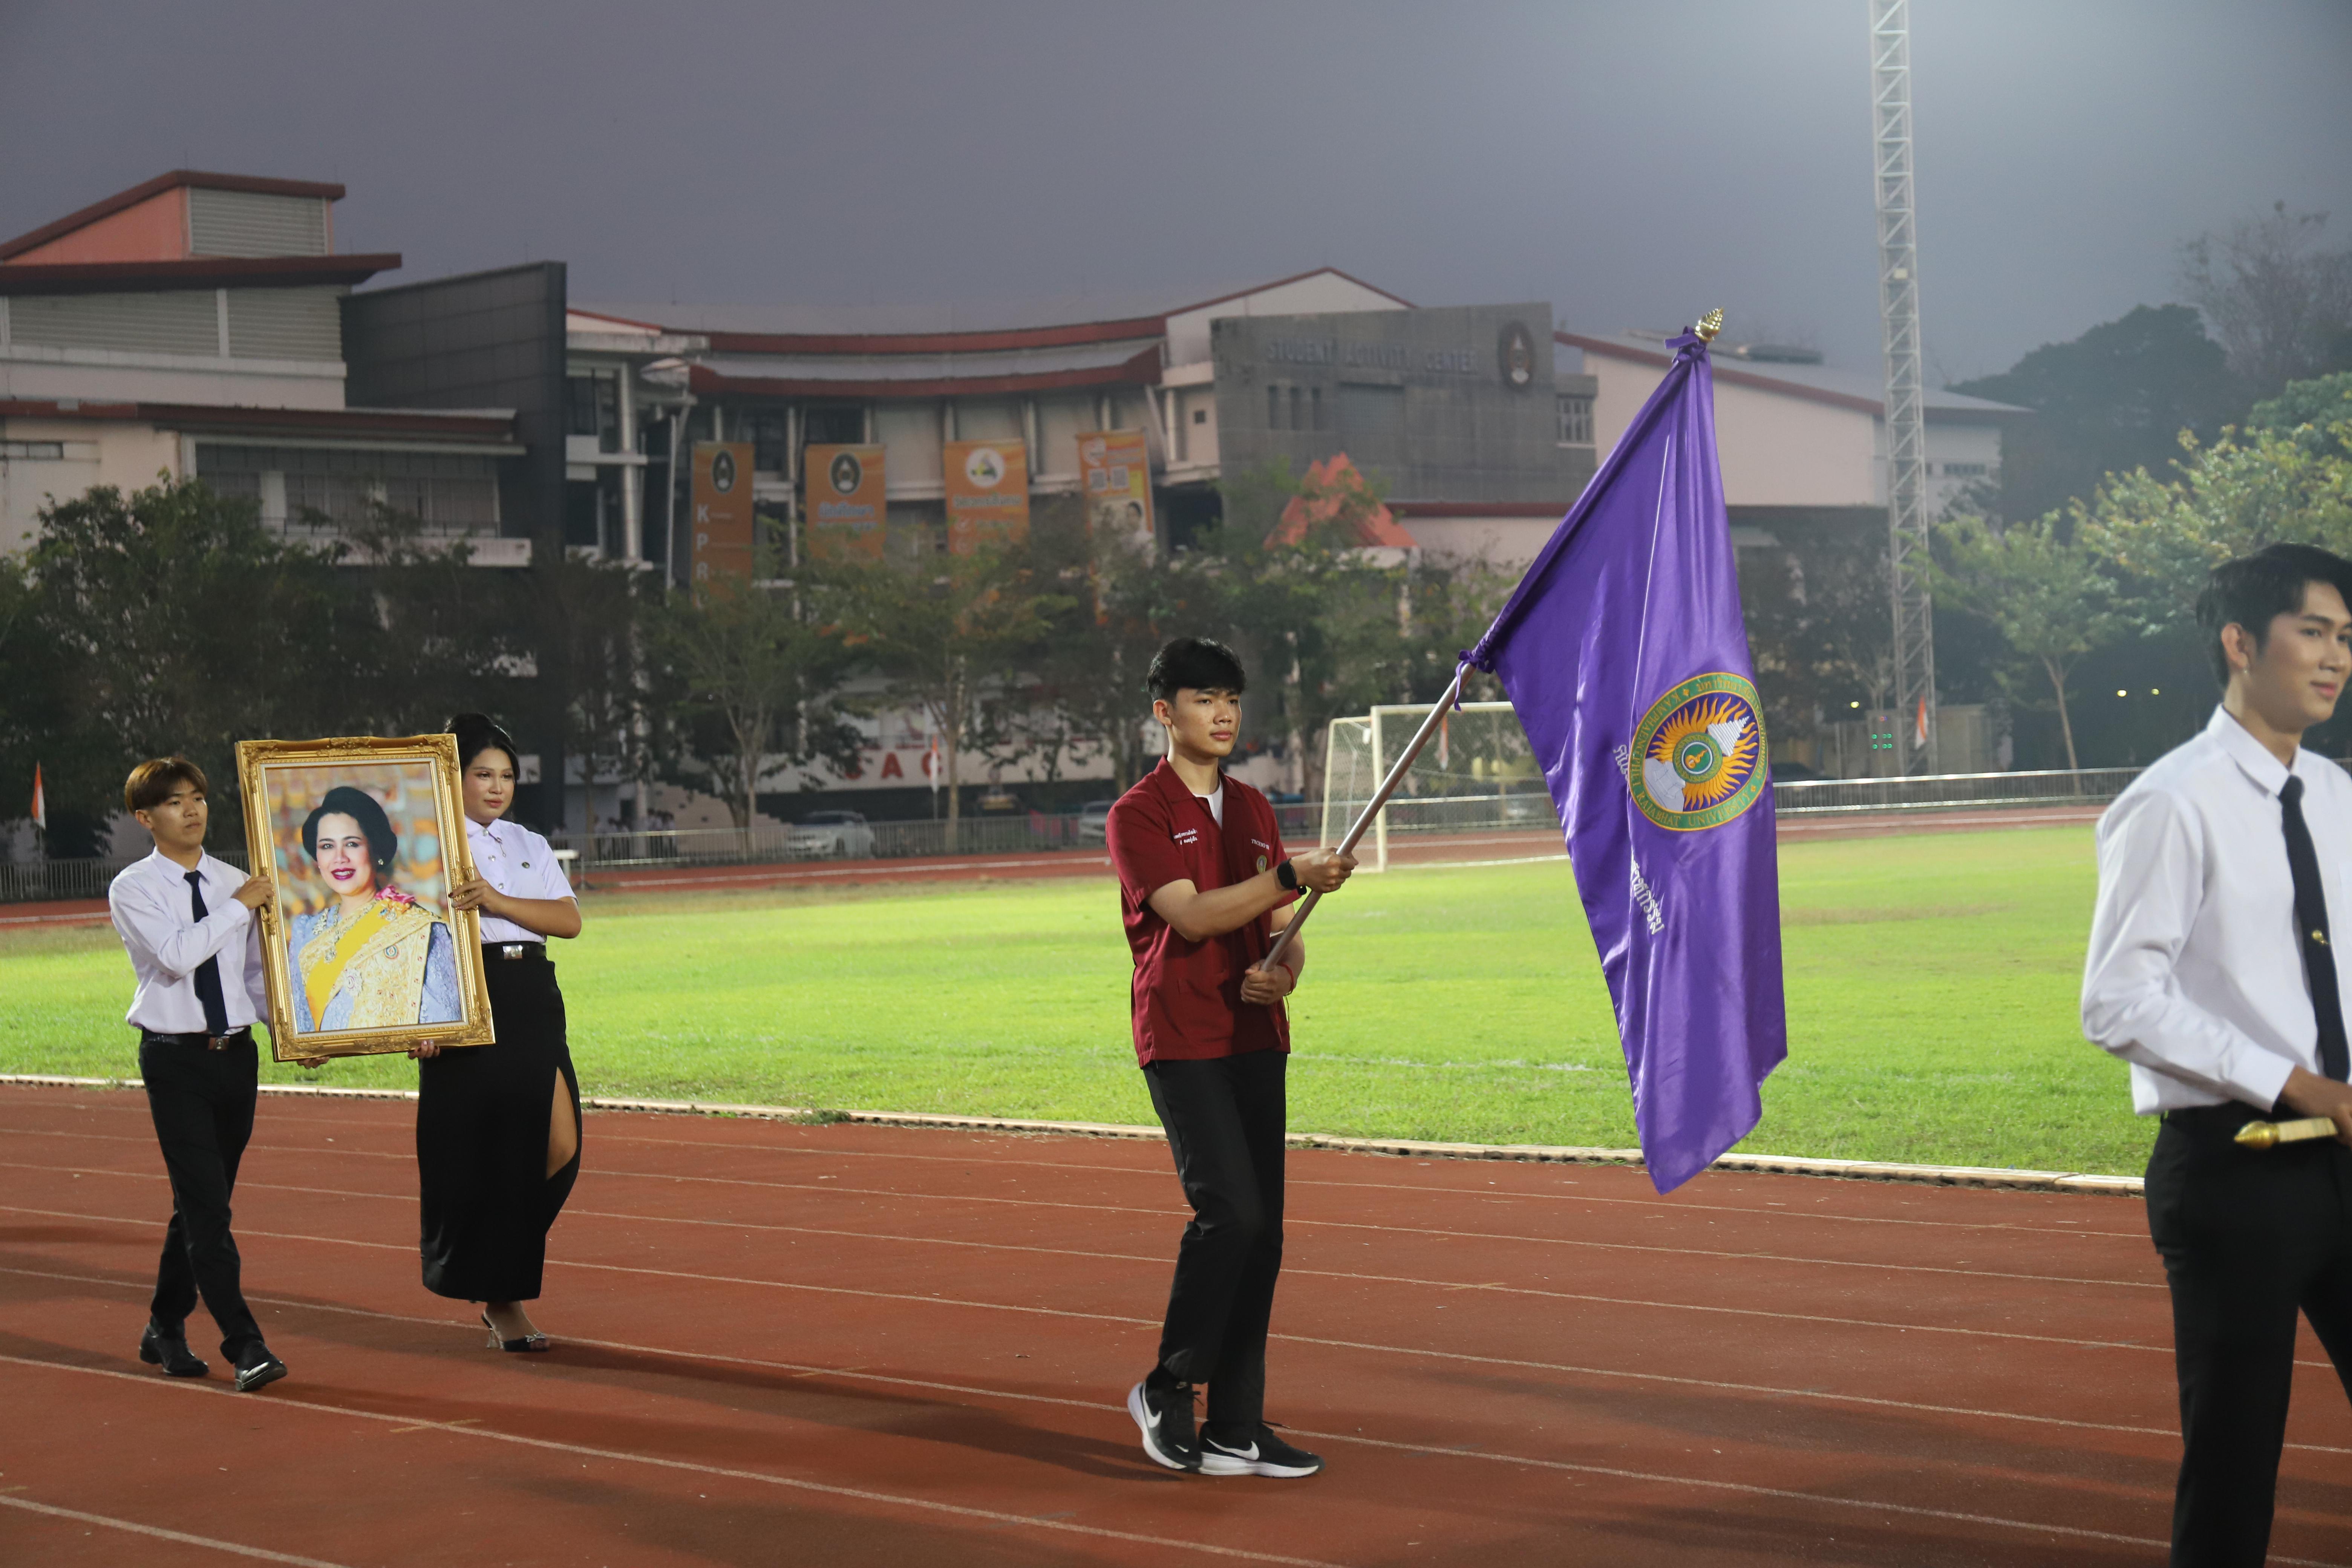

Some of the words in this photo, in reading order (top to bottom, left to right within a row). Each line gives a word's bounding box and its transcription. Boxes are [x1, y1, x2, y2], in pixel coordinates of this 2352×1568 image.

[1268, 338, 1336, 363] STUDENT
[1426, 348, 1478, 373] CENTER
[1636, 791, 1681, 827] RAJABHAT
[1688, 791, 1750, 826] UNIVERSITY
